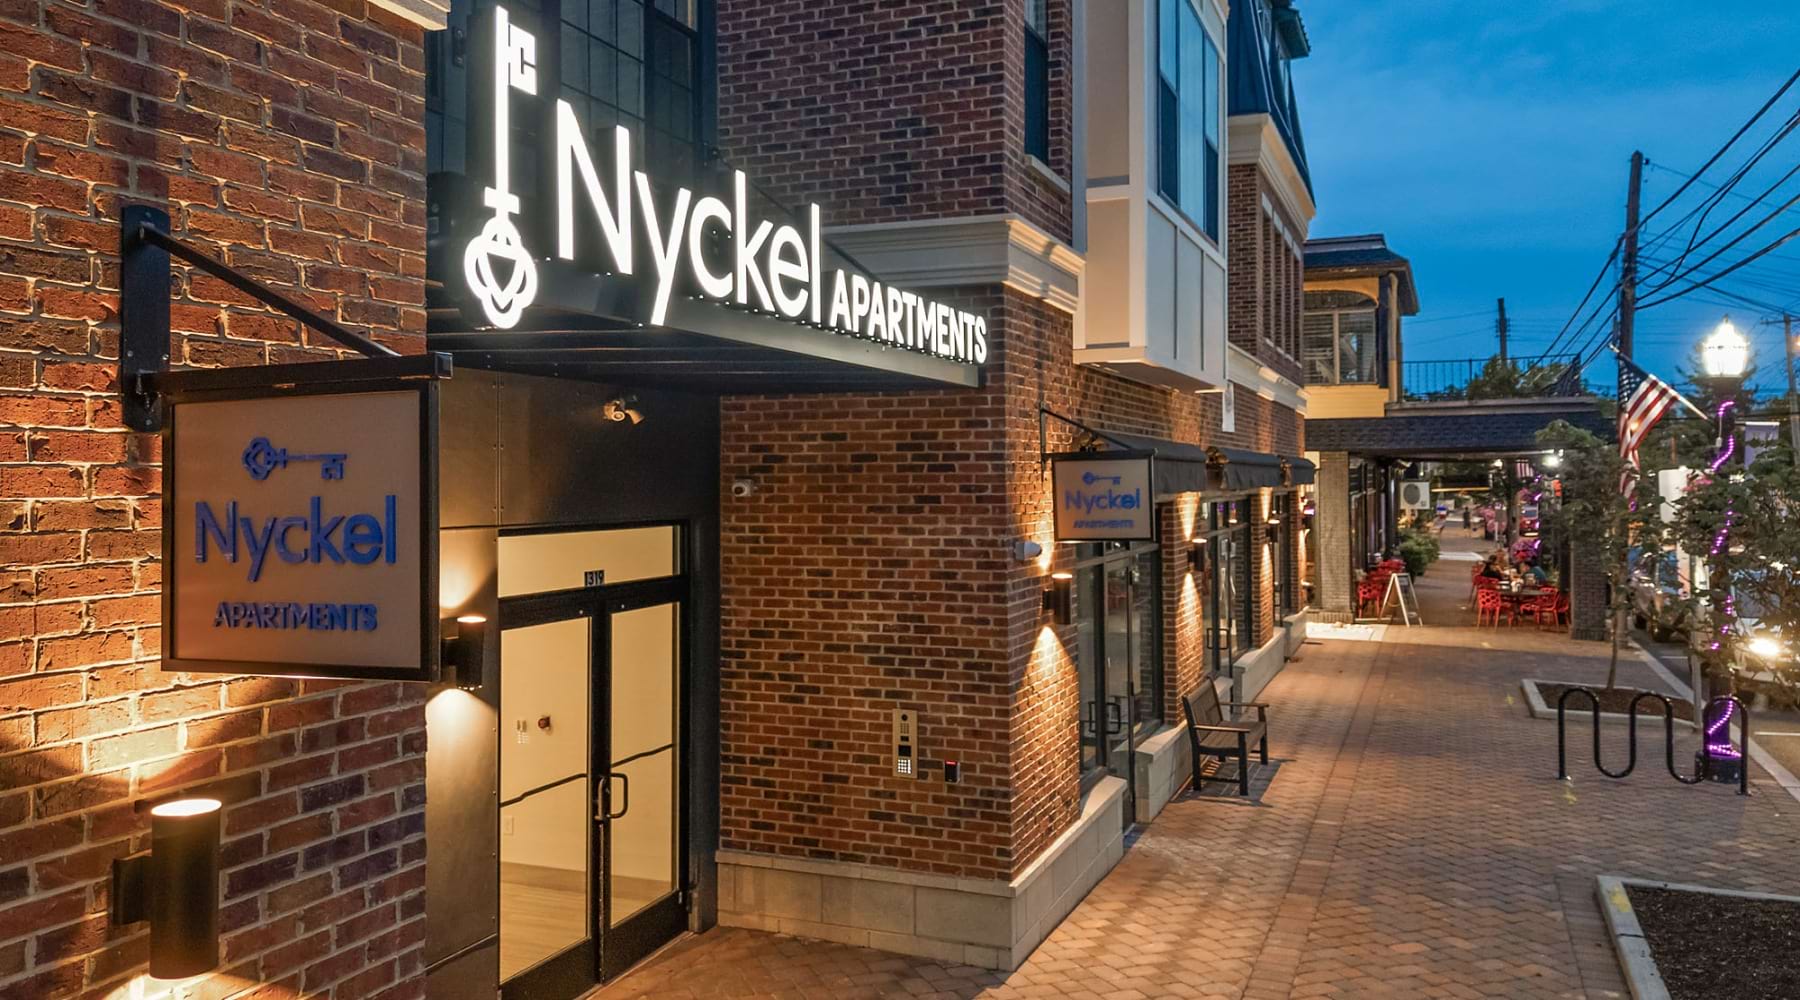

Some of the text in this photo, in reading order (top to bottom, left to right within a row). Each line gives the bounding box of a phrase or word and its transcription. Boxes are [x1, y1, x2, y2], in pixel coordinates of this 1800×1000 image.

[557, 98, 988, 364] Nyckel APARTMENTS
[1065, 487, 1141, 515] Nyckel
[194, 494, 397, 582] Nyckel
[213, 601, 378, 632] APARTMENTS
